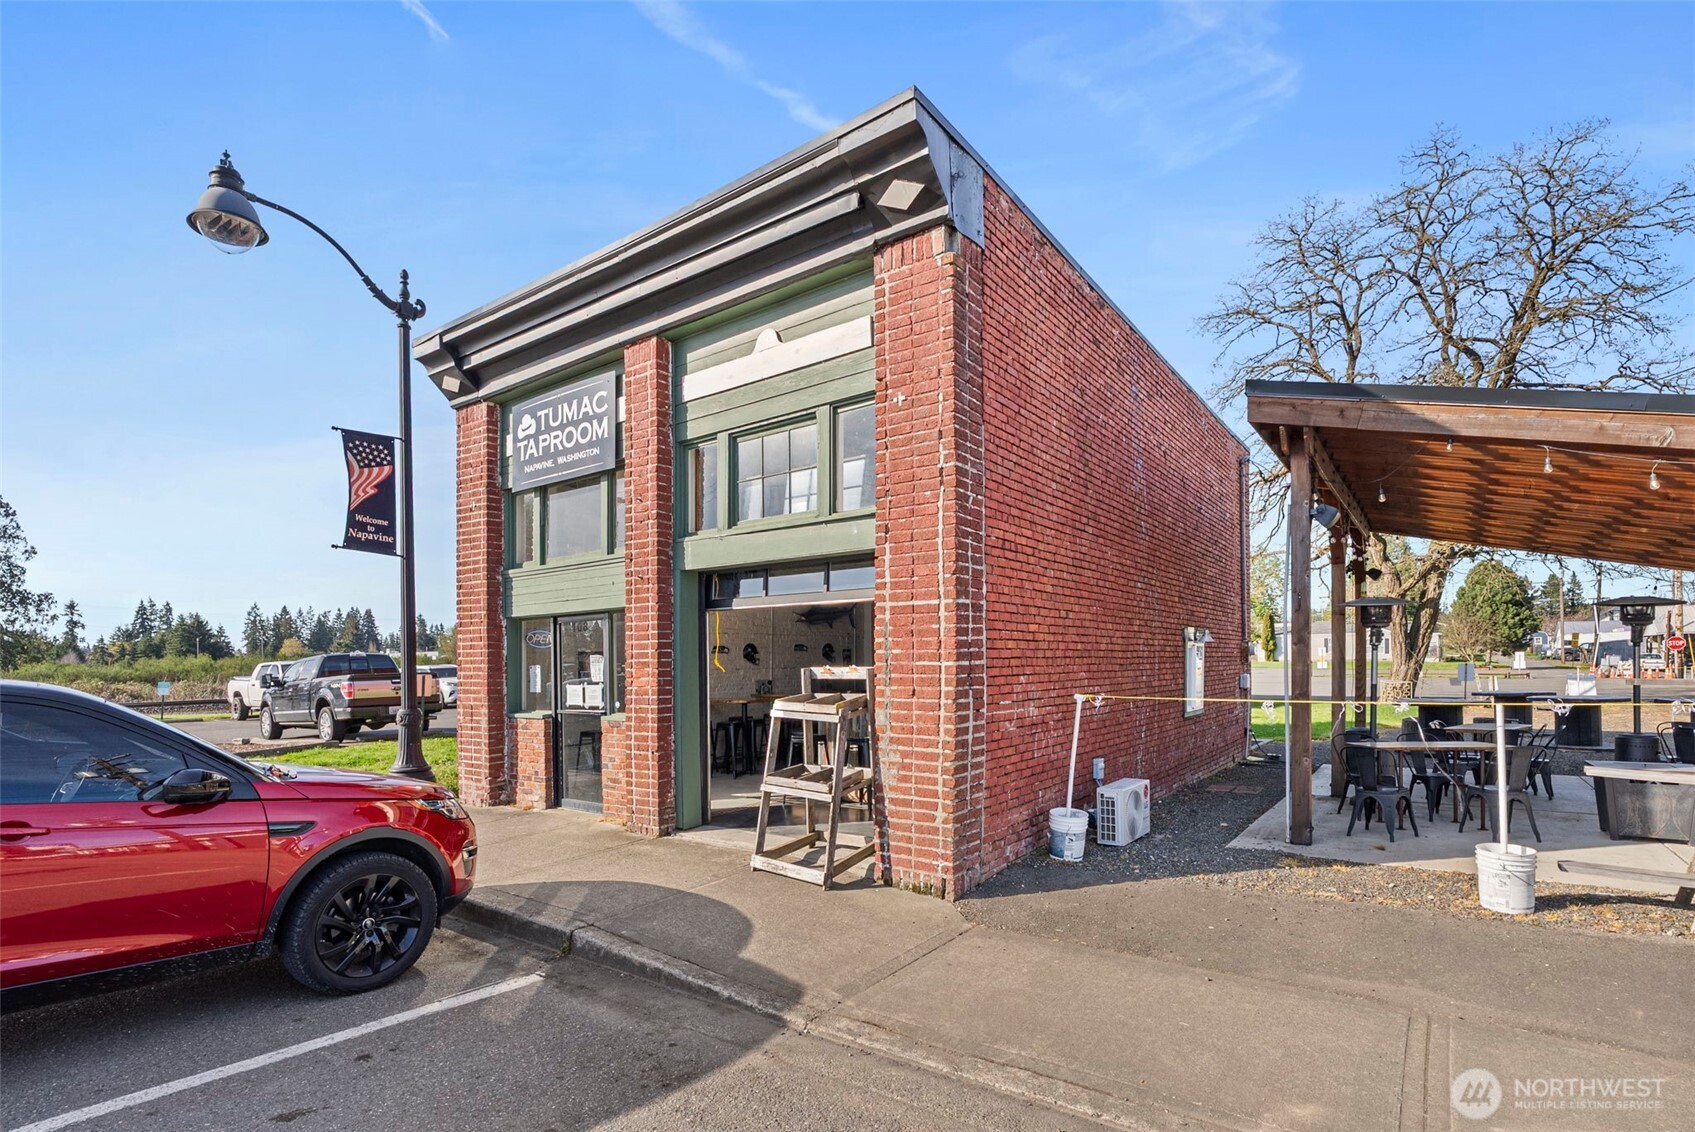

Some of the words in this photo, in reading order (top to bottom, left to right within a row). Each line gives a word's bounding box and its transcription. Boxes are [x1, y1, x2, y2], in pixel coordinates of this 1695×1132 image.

[537, 391, 608, 431] TUMAC
[517, 416, 608, 461] TAPROOM
[557, 447, 600, 465] WASHINGTON
[355, 514, 389, 526] Welcome
[348, 528, 394, 543] Napavine
